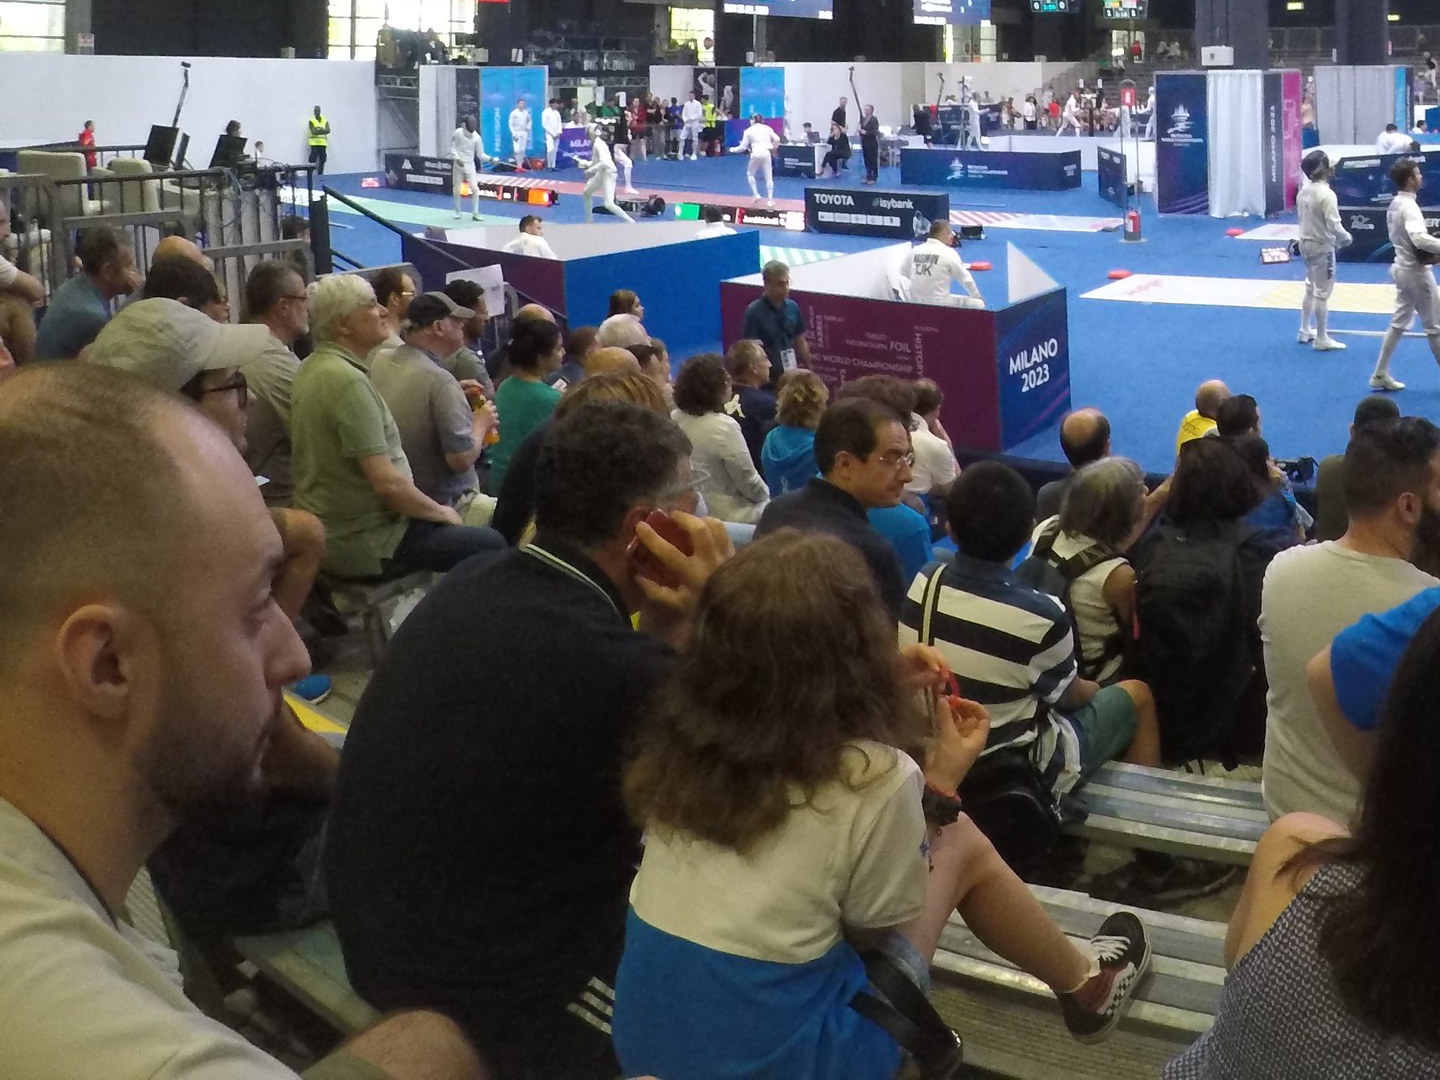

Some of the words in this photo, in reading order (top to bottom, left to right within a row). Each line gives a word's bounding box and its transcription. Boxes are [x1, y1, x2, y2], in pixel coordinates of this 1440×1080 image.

[814, 193, 855, 206] TOYOTA
[889, 341, 911, 353] FOIL
[822, 354, 850, 365] WORLD
[1009, 338, 1059, 376] MILANO
[1021, 363, 1050, 393] 2023
